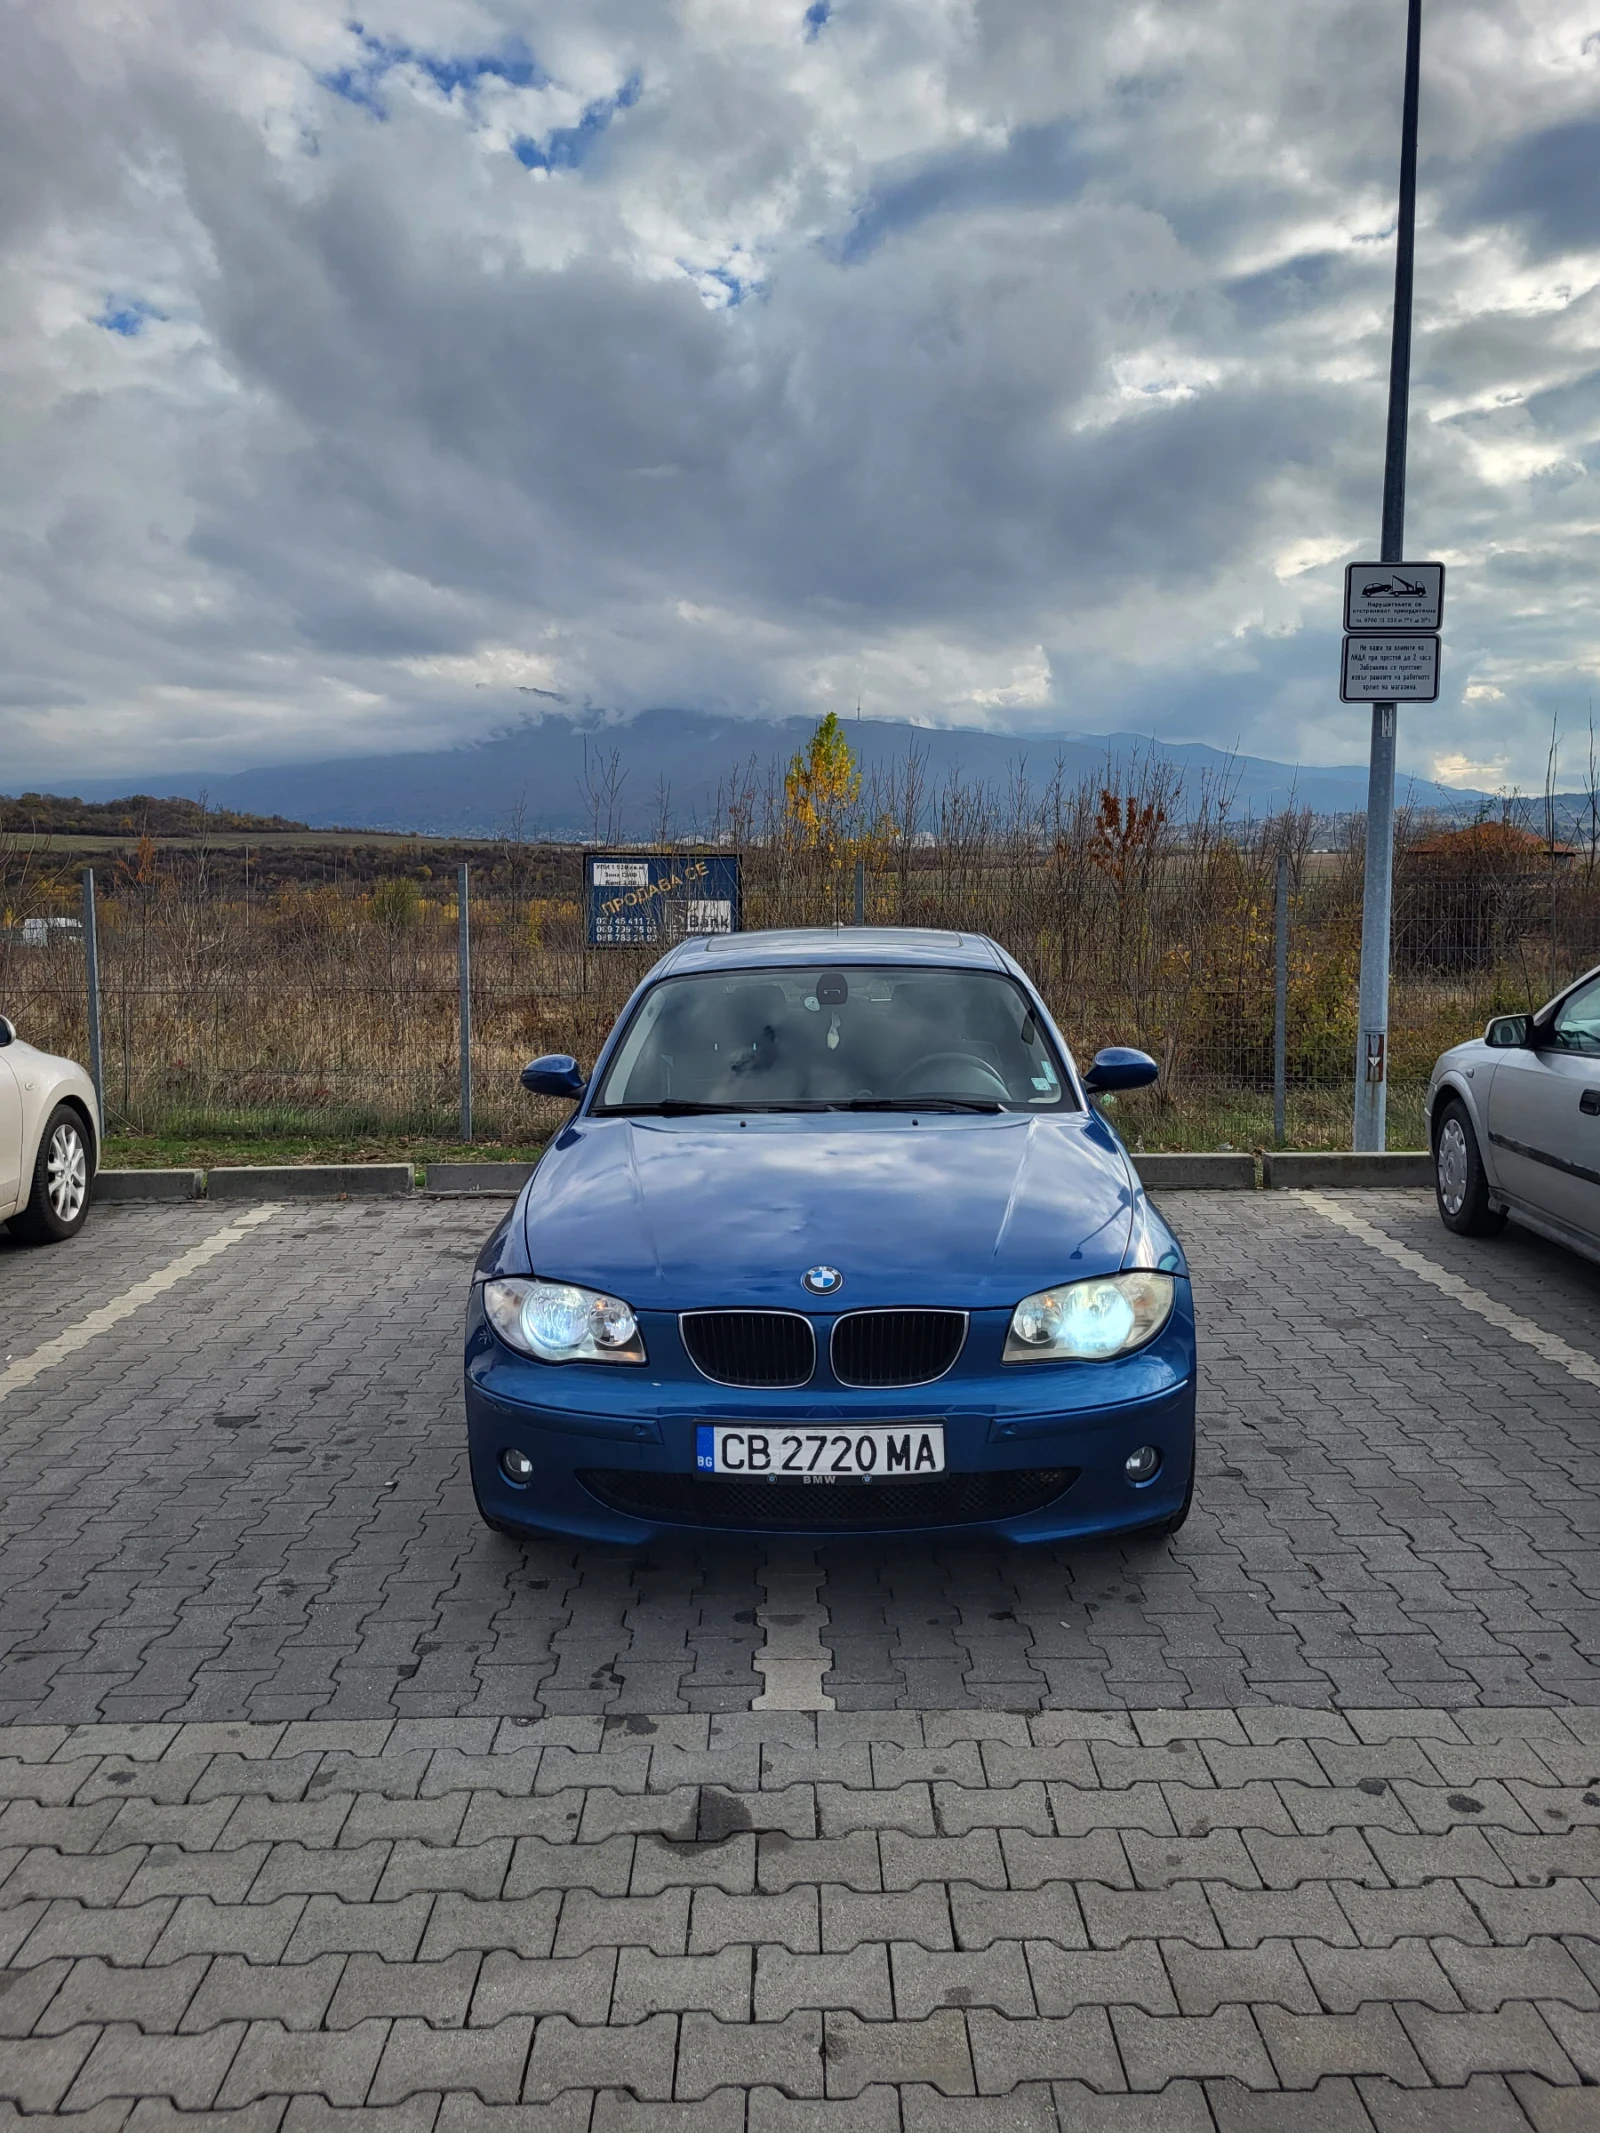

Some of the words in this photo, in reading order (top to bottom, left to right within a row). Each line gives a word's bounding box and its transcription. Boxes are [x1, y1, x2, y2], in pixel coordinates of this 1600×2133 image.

[1380, 654, 1401, 662] престой
[1403, 673, 1430, 682] работното
[1363, 684, 1379, 692] време
[601, 874, 683, 916] ПРОДАВА
[684, 861, 710, 880] СЕ
[689, 915, 730, 928] Bank
[697, 1456, 713, 1467] BG
[721, 1433, 772, 1470] CB
[781, 1434, 877, 1472] 2720
[886, 1433, 937, 1472] MA
[802, 1475, 836, 1484] BMW
